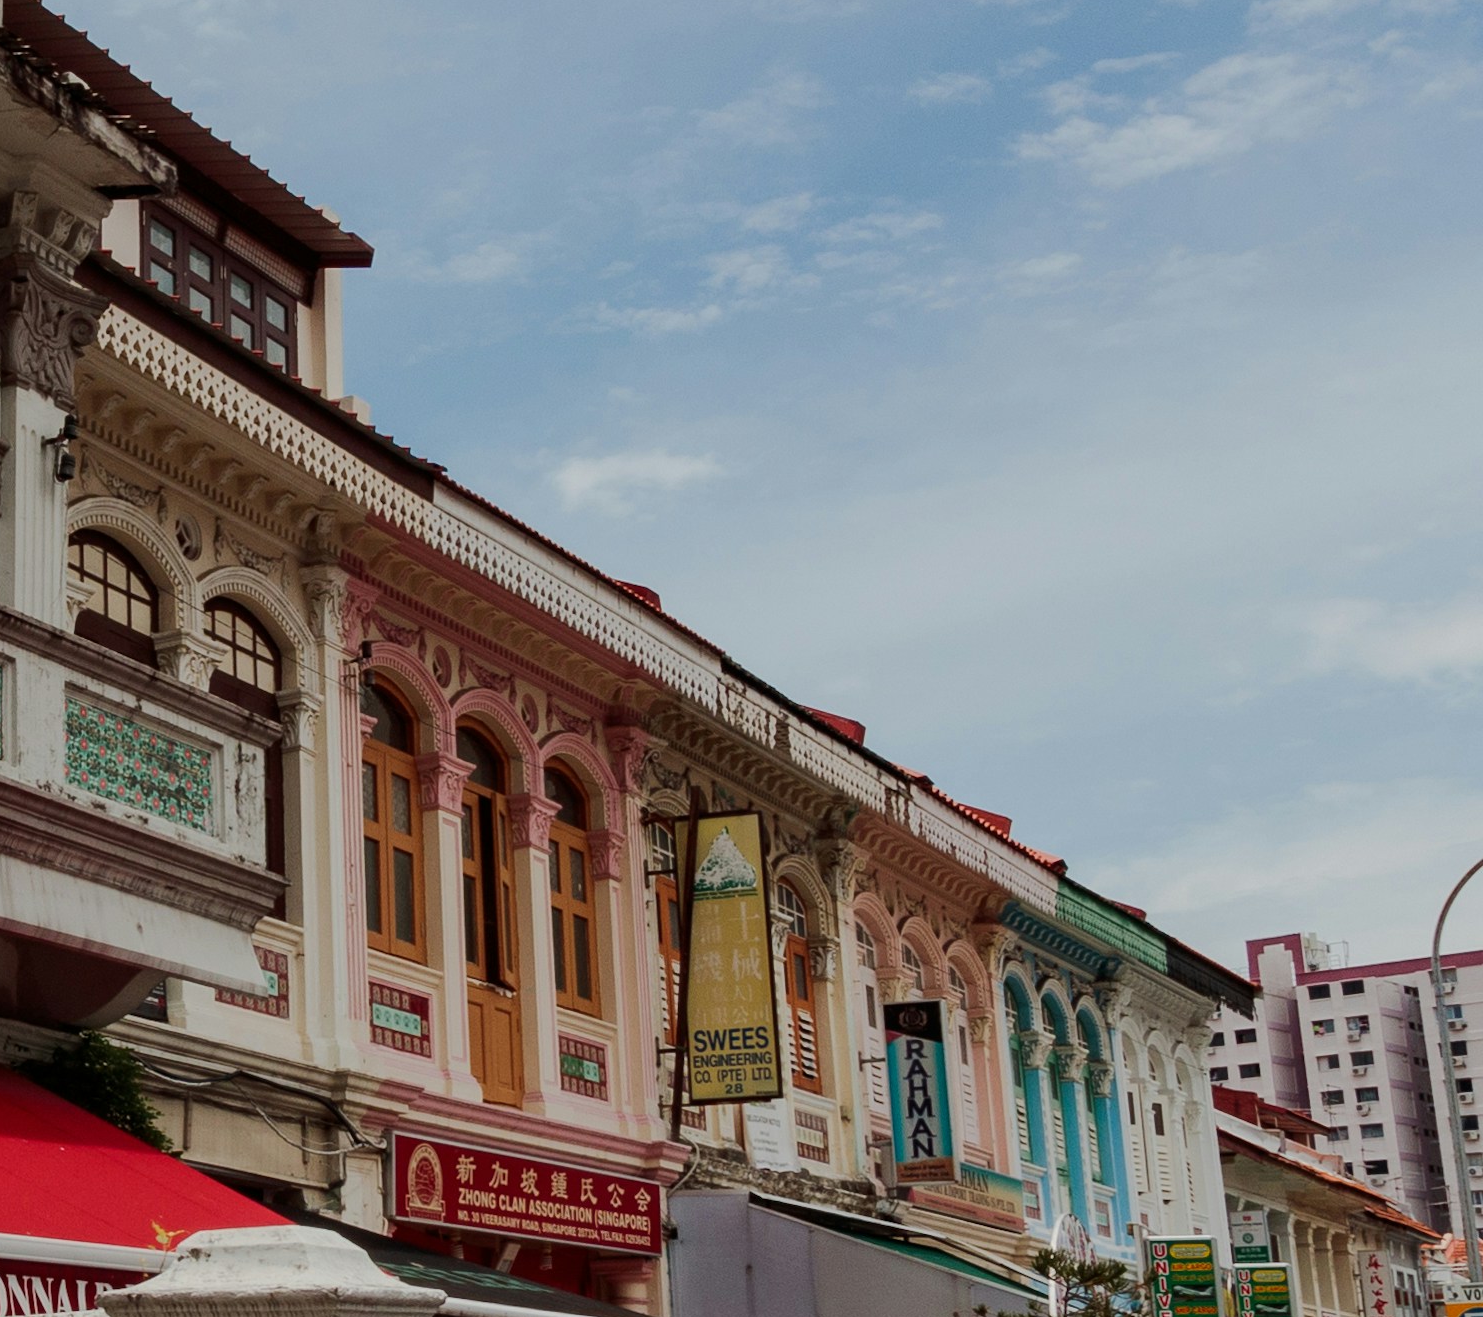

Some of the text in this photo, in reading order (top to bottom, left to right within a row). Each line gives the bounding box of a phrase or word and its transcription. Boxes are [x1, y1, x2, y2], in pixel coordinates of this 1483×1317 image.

[694, 1027, 769, 1052] SWEES
[693, 1052, 773, 1069] ENGINEERING
[695, 1067, 773, 1083] CO. (PTE) LTD.
[725, 1083, 743, 1095] 28
[903, 1039, 937, 1158] RAHMAN
[458, 1187, 651, 1233] ZHONG CLAN ASSOCIATION (SINGAPORE)
[458, 1210, 470, 1222] NO.
[472, 1212, 480, 1223] 30
[481, 1213, 521, 1230] VEERASAMY
[542, 1220, 577, 1237] SINGAPORE
